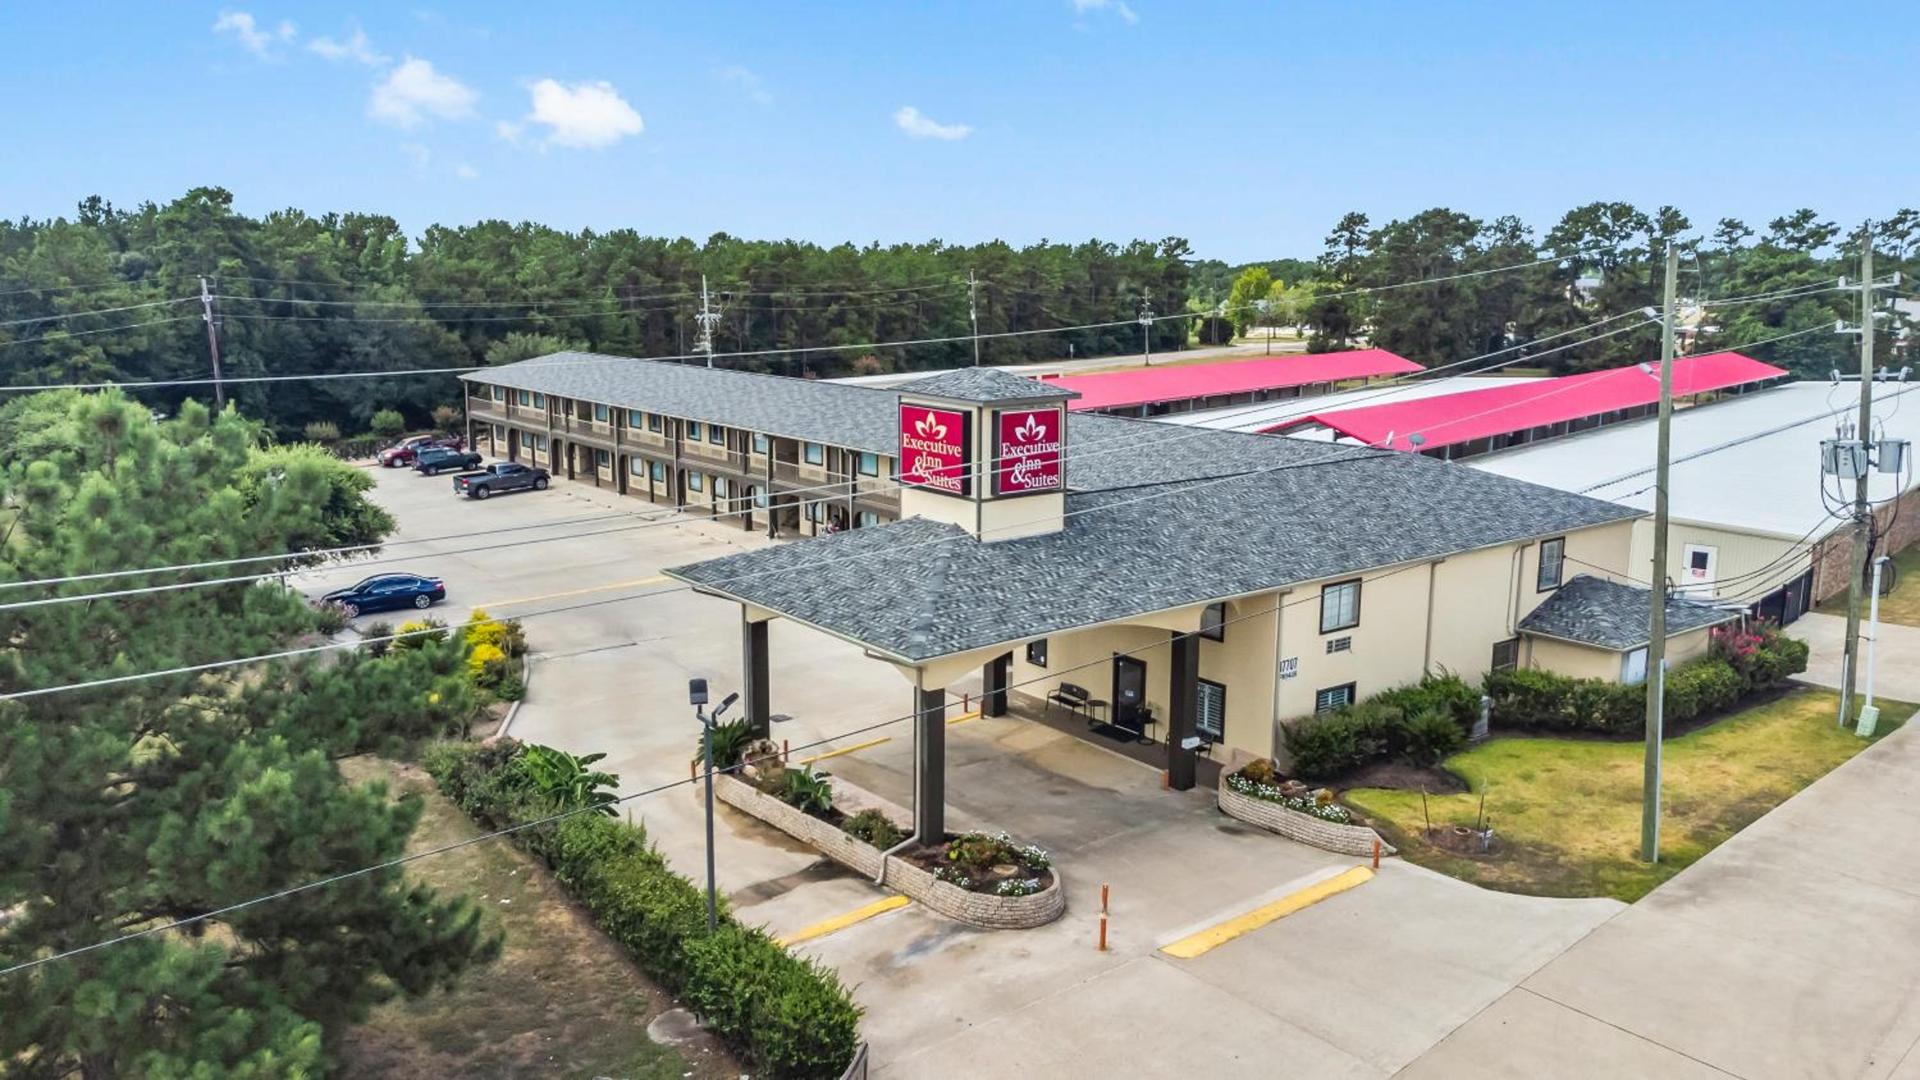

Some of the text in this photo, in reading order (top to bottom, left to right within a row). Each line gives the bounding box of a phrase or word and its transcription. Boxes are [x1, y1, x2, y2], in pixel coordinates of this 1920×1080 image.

[902, 432, 962, 458] Executive
[1001, 440, 1059, 457] Executive
[922, 451, 942, 470] Inn
[1021, 456, 1041, 470] Inn
[912, 454, 961, 490] & Suites
[1010, 462, 1058, 489] & Suites
